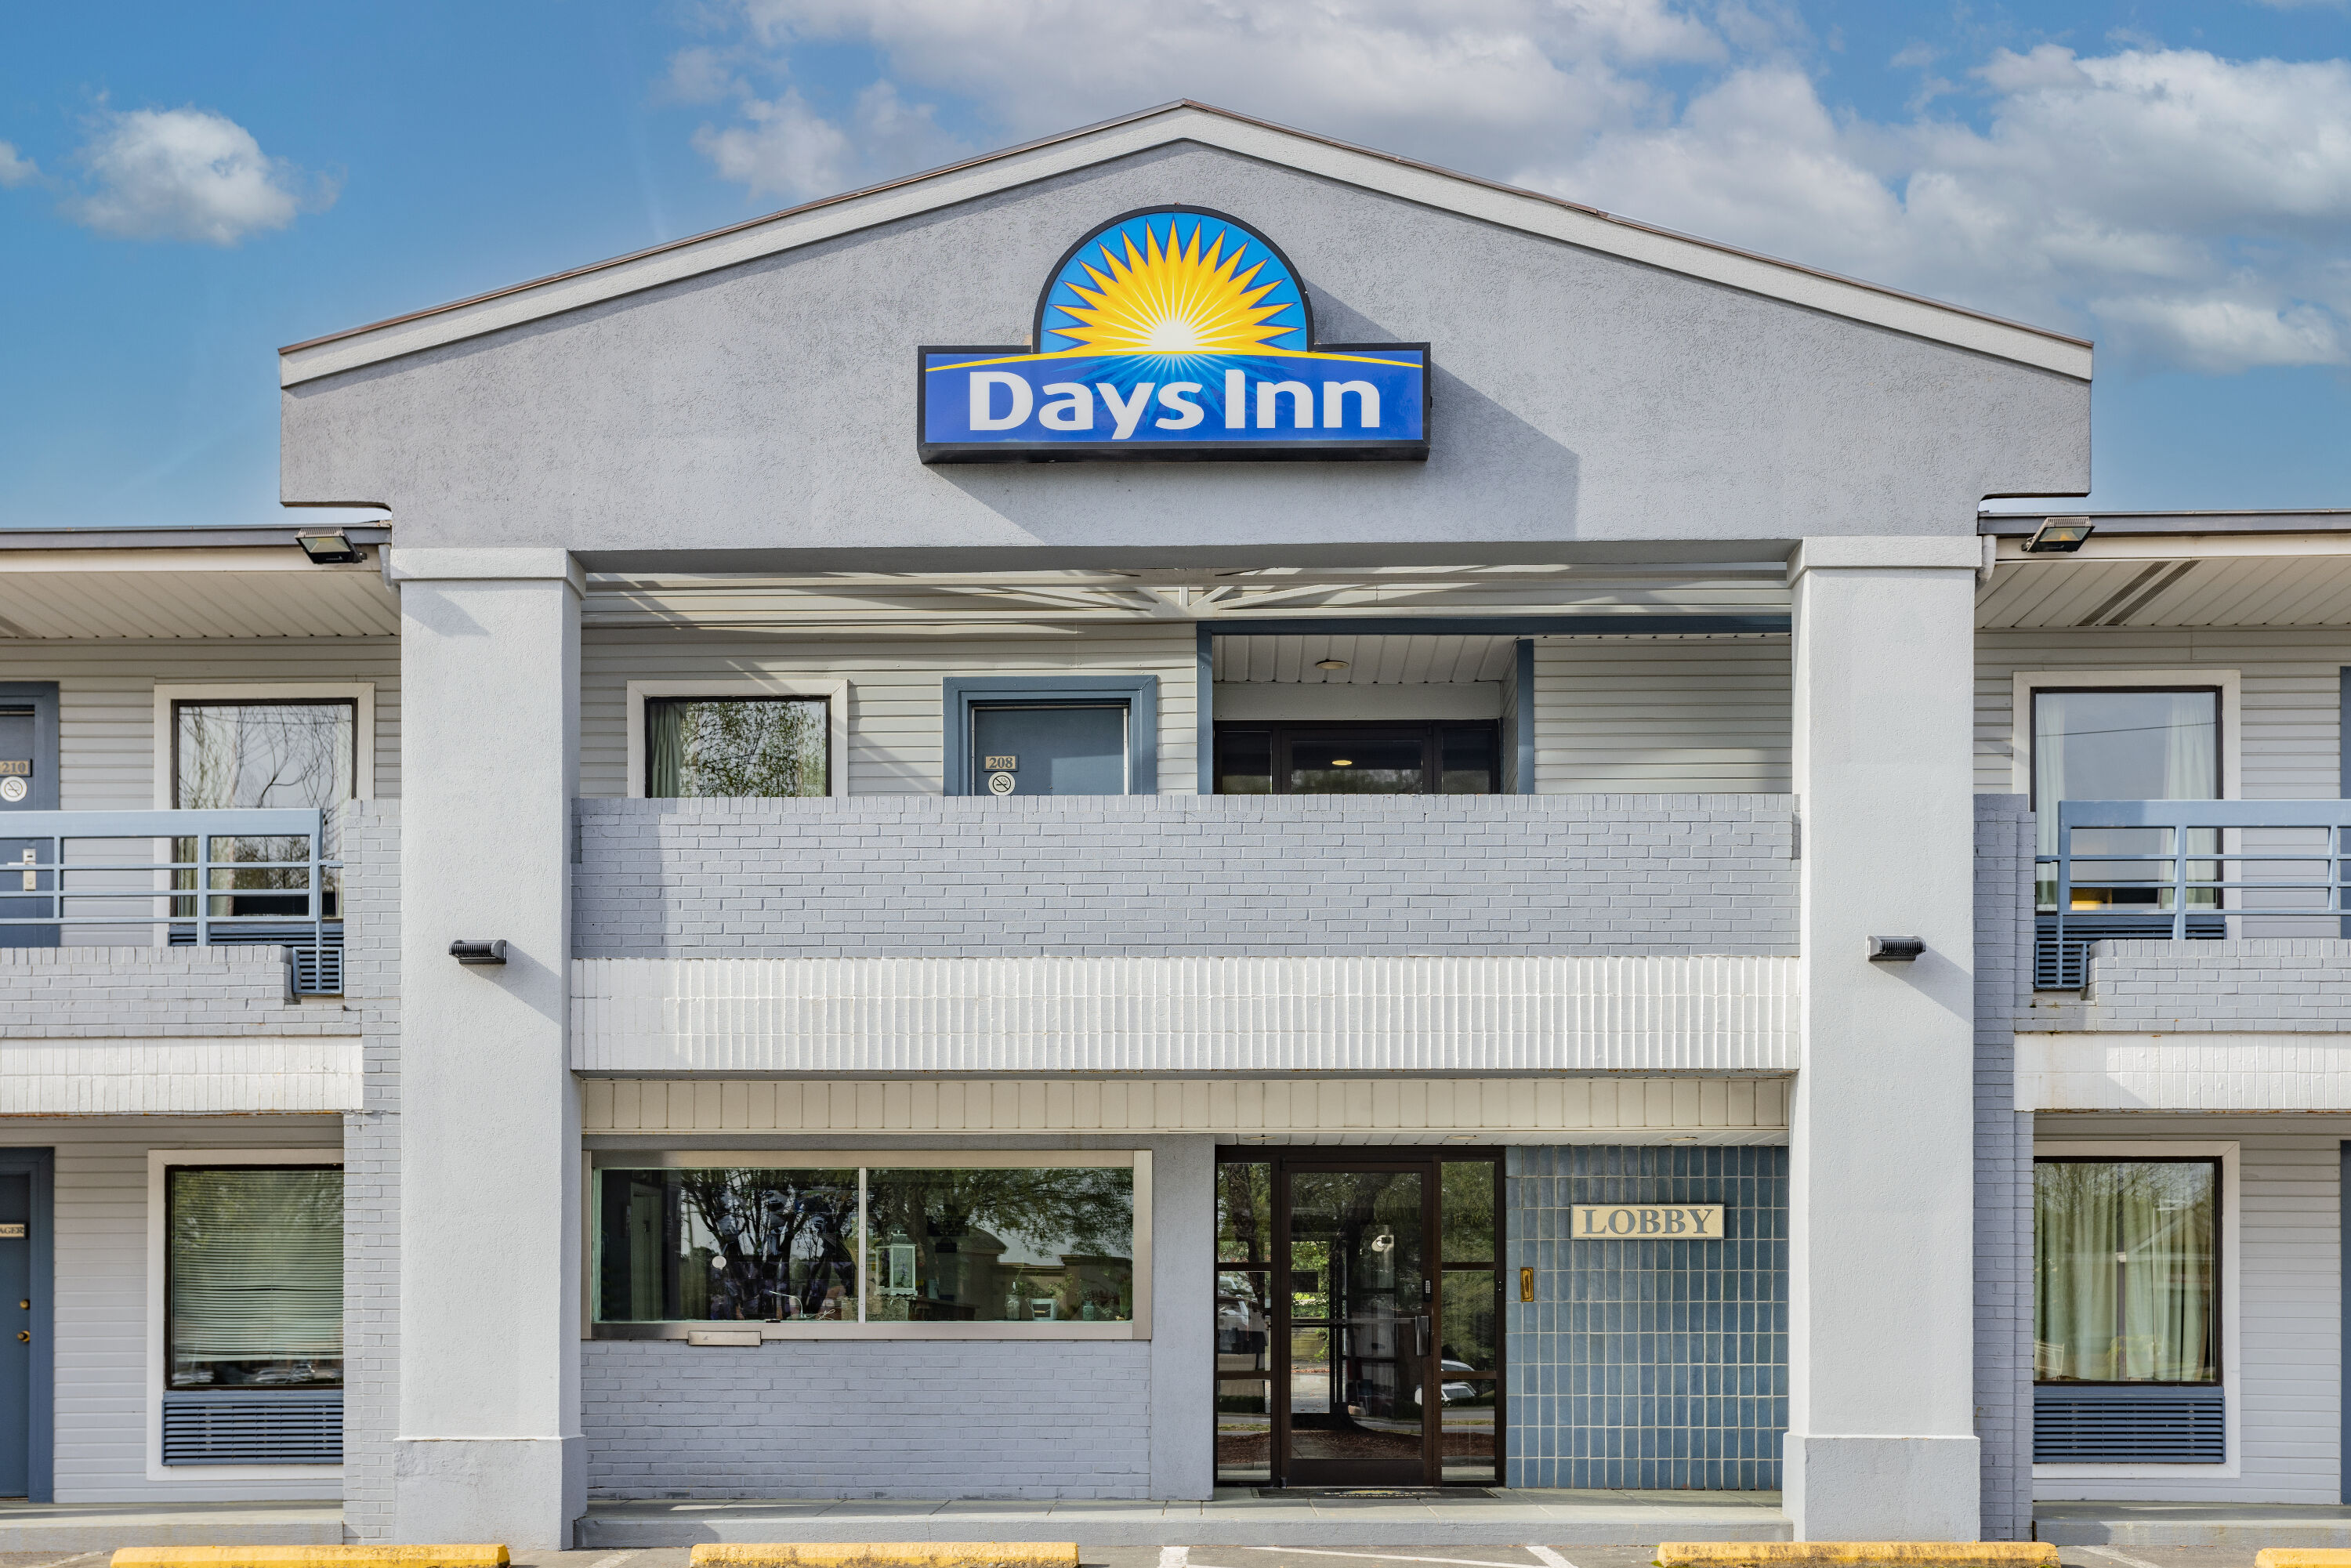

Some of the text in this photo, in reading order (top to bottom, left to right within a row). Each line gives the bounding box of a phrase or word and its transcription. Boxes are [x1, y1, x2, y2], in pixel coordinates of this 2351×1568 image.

[969, 369, 1380, 440] Days Inn
[2, 762, 26, 773] 210
[989, 757, 1013, 769] 208
[1582, 1209, 1714, 1235] LOBBY
